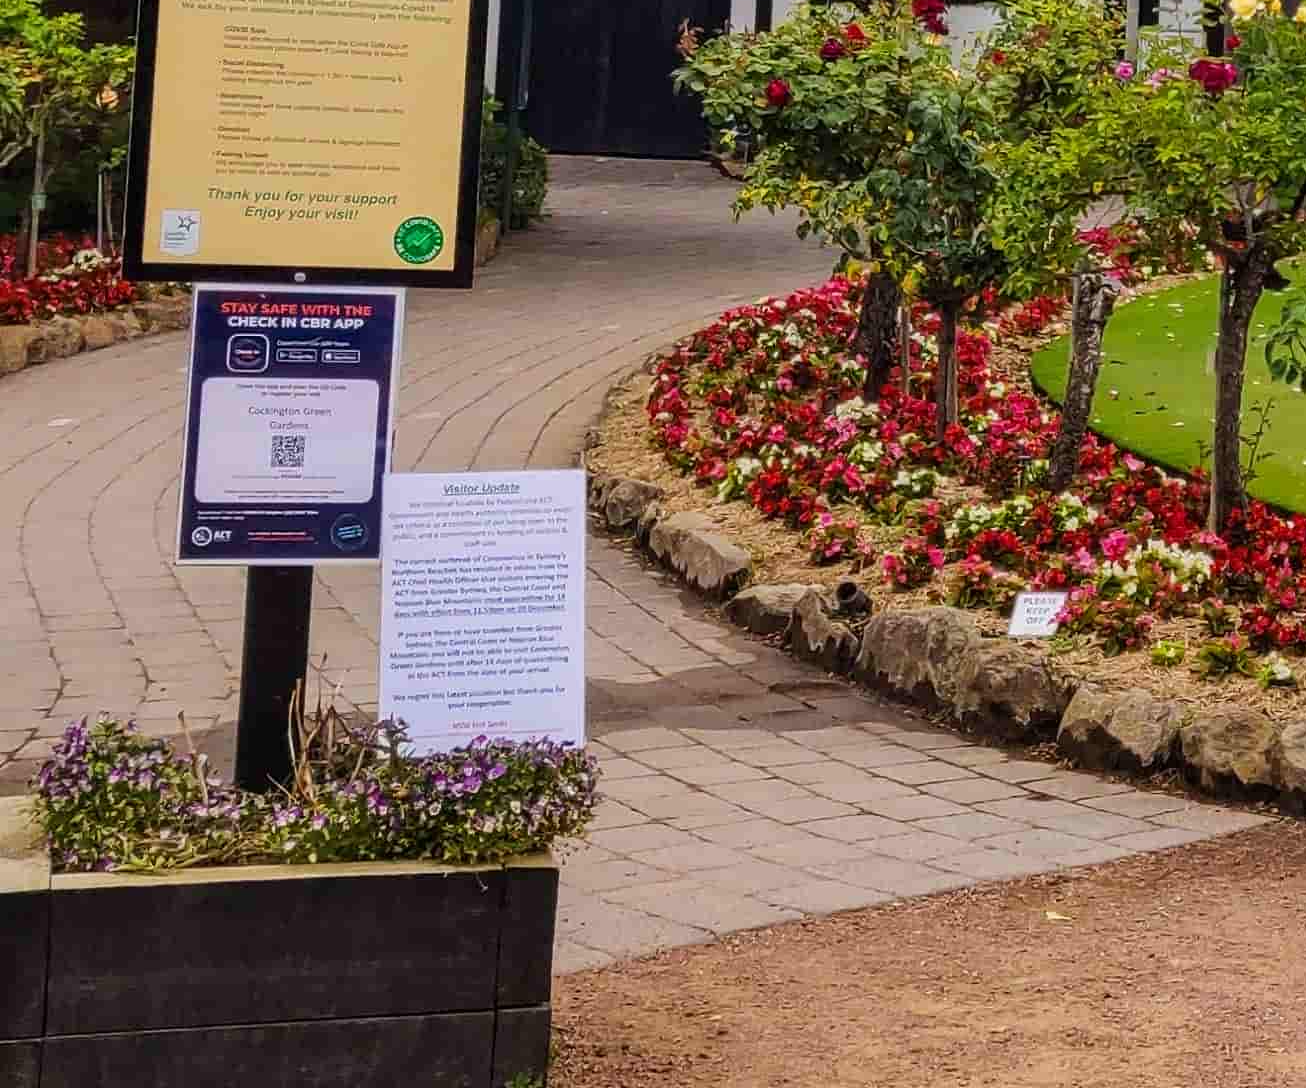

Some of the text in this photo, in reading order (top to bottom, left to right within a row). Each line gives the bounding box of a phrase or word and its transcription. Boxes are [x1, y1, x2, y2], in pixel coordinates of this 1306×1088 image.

[207, 187, 398, 209] Thank you for your support
[244, 205, 360, 222] Enjoy your visit!
[220, 301, 257, 315] STAY
[261, 303, 298, 316] SAFE
[302, 304, 341, 316] WITH
[226, 315, 365, 330] CHECK IN CBR APP
[443, 482, 520, 495] Visitor Update
